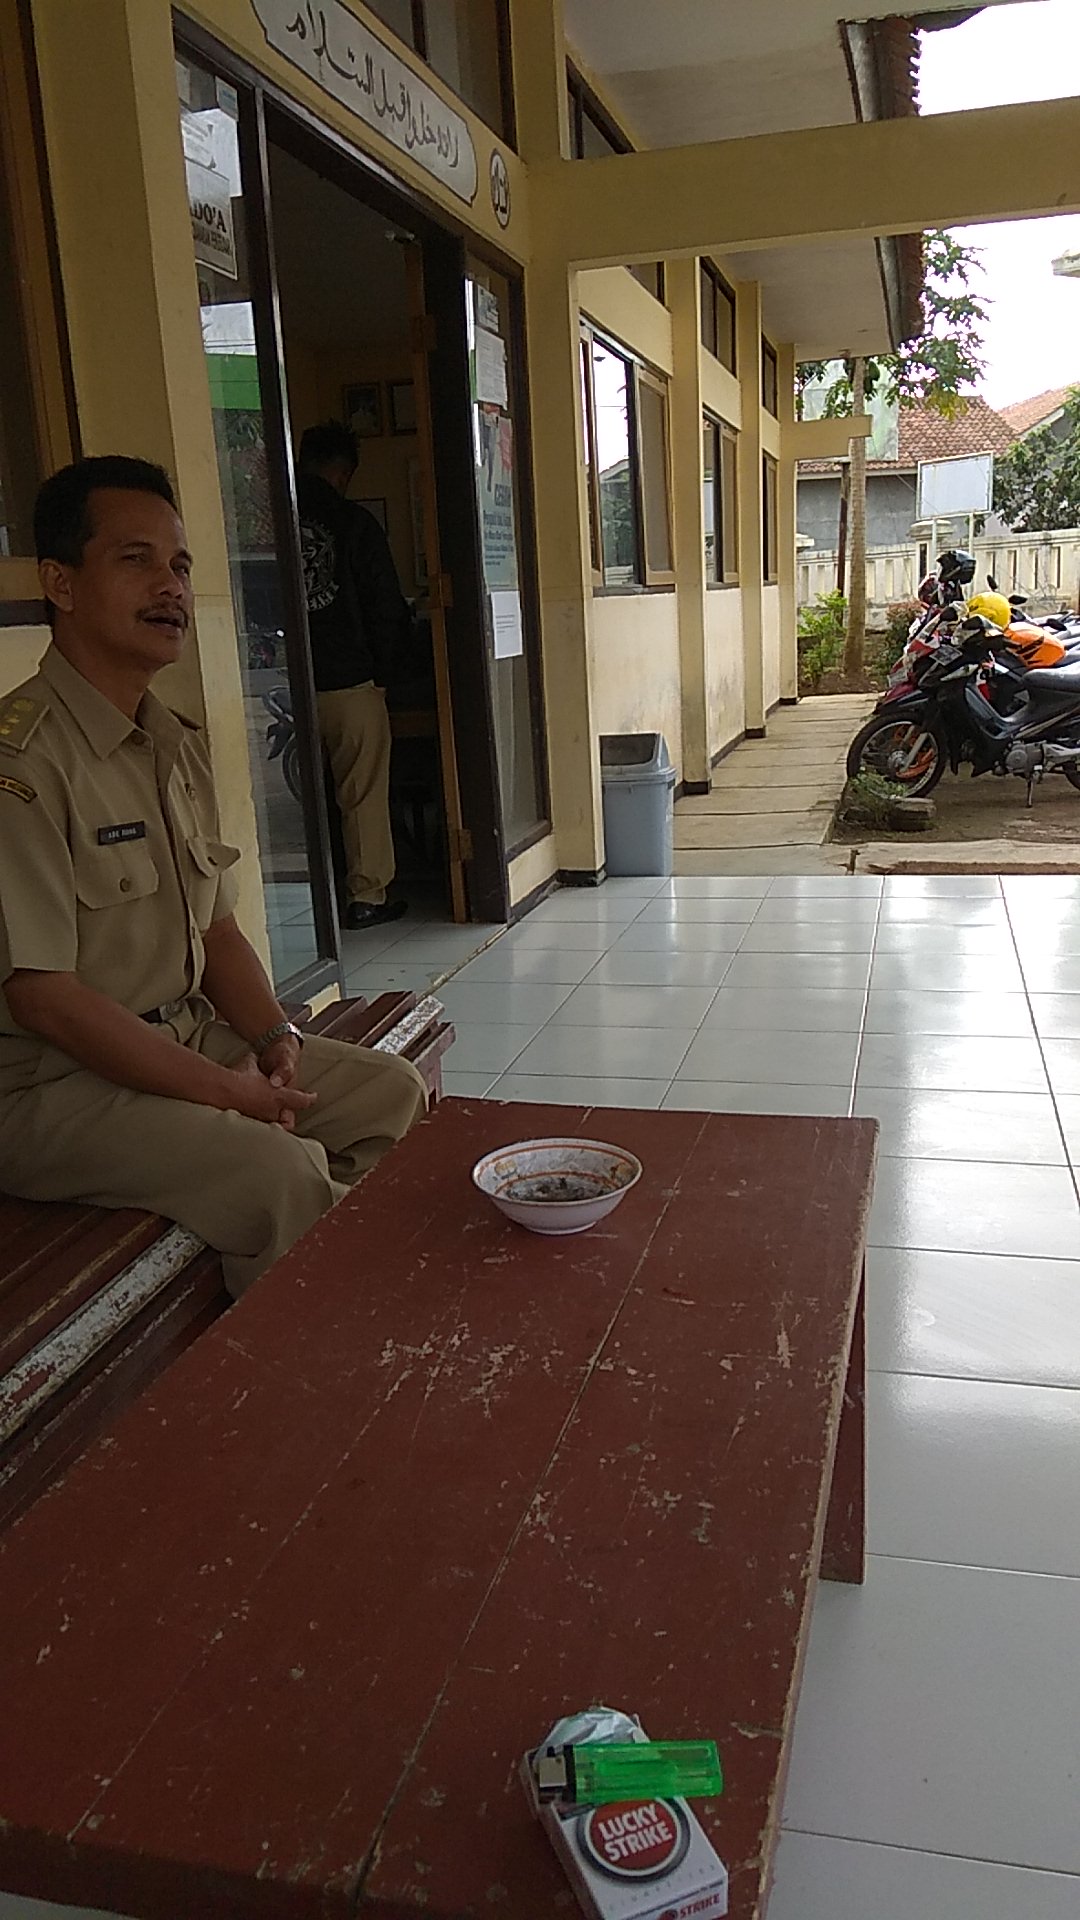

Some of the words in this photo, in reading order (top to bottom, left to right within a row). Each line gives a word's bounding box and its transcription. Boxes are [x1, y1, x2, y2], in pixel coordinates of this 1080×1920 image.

[598, 1803, 658, 1841] LUCKY
[604, 1820, 673, 1862] STRIKE
[680, 1893, 720, 1917] STRIKE
